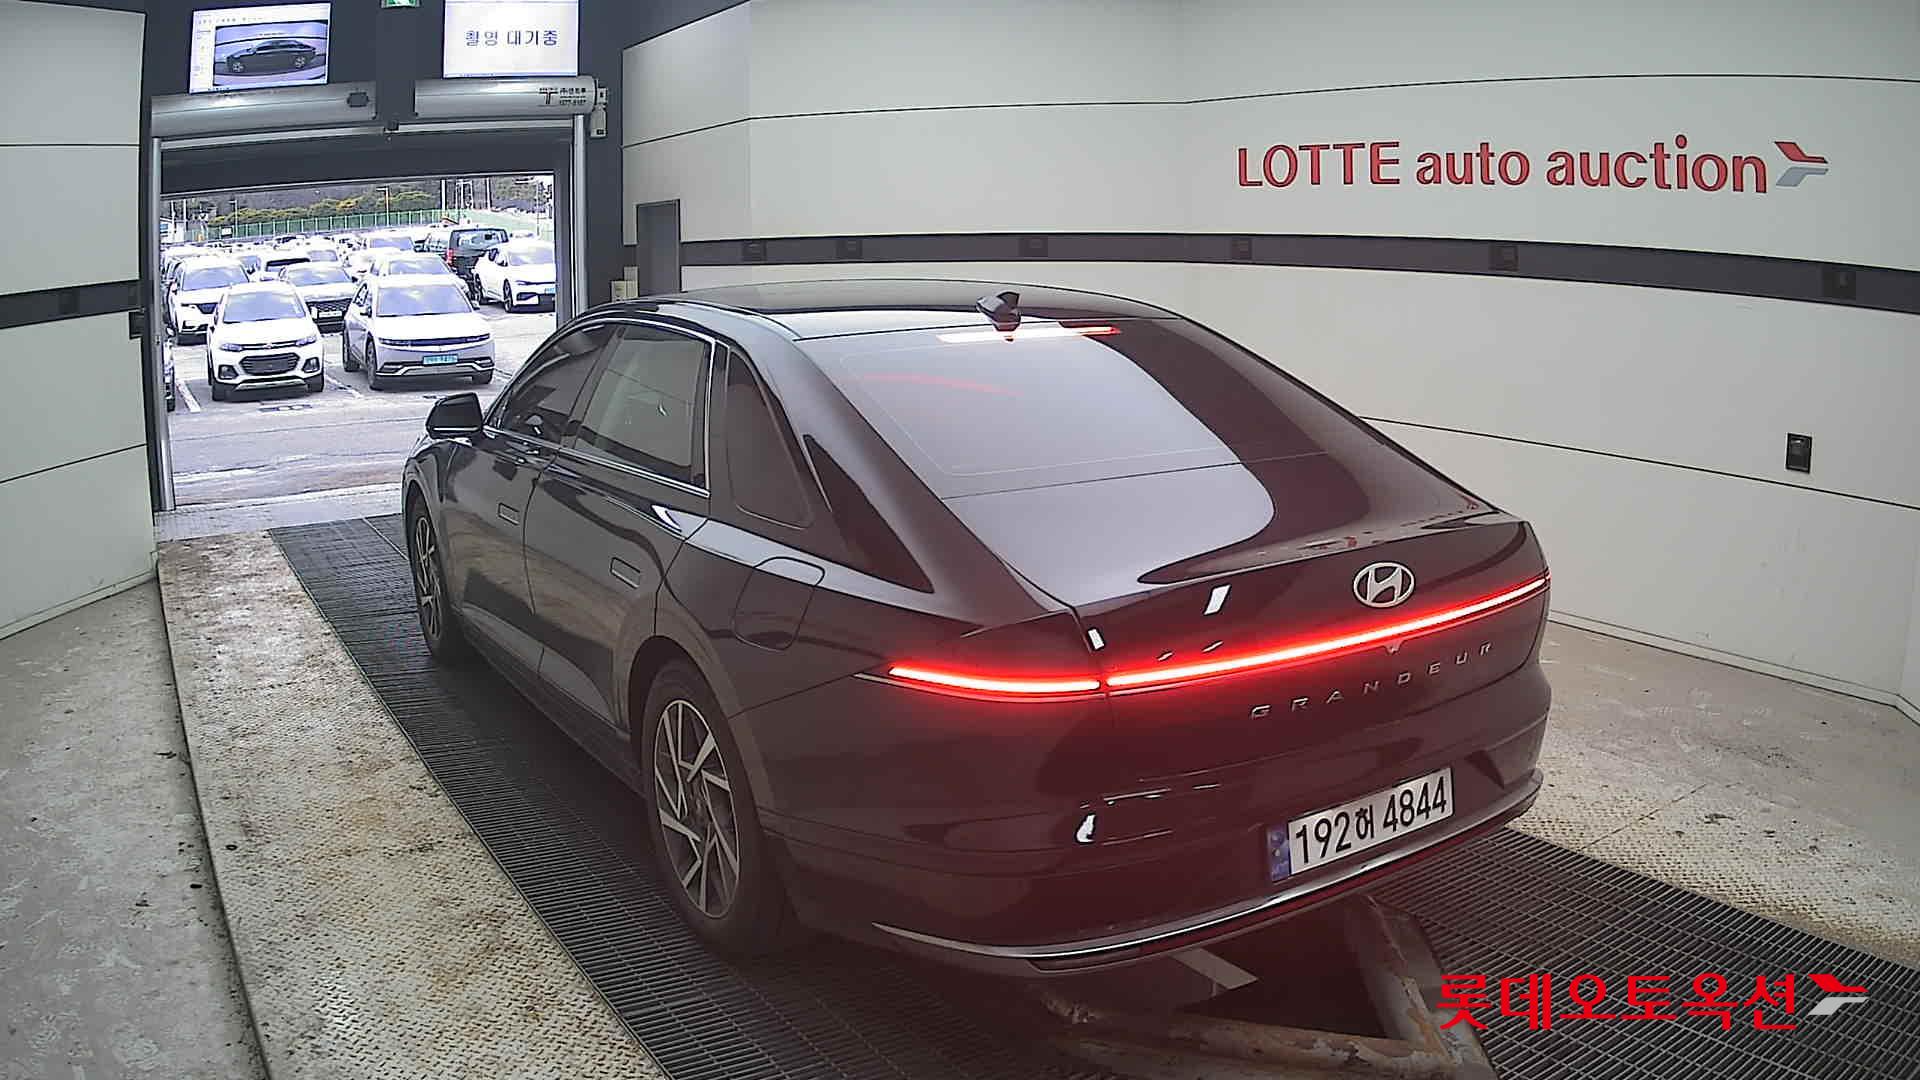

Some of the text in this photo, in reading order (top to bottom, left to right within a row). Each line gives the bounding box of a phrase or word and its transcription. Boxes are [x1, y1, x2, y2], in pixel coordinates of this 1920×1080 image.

[465, 29, 558, 47] 촬영 대기중
[1238, 134, 1767, 194] LOTTE auto auction
[1251, 641, 1492, 720] GRANDEUR
[1295, 776, 1448, 865] 192허 4844
